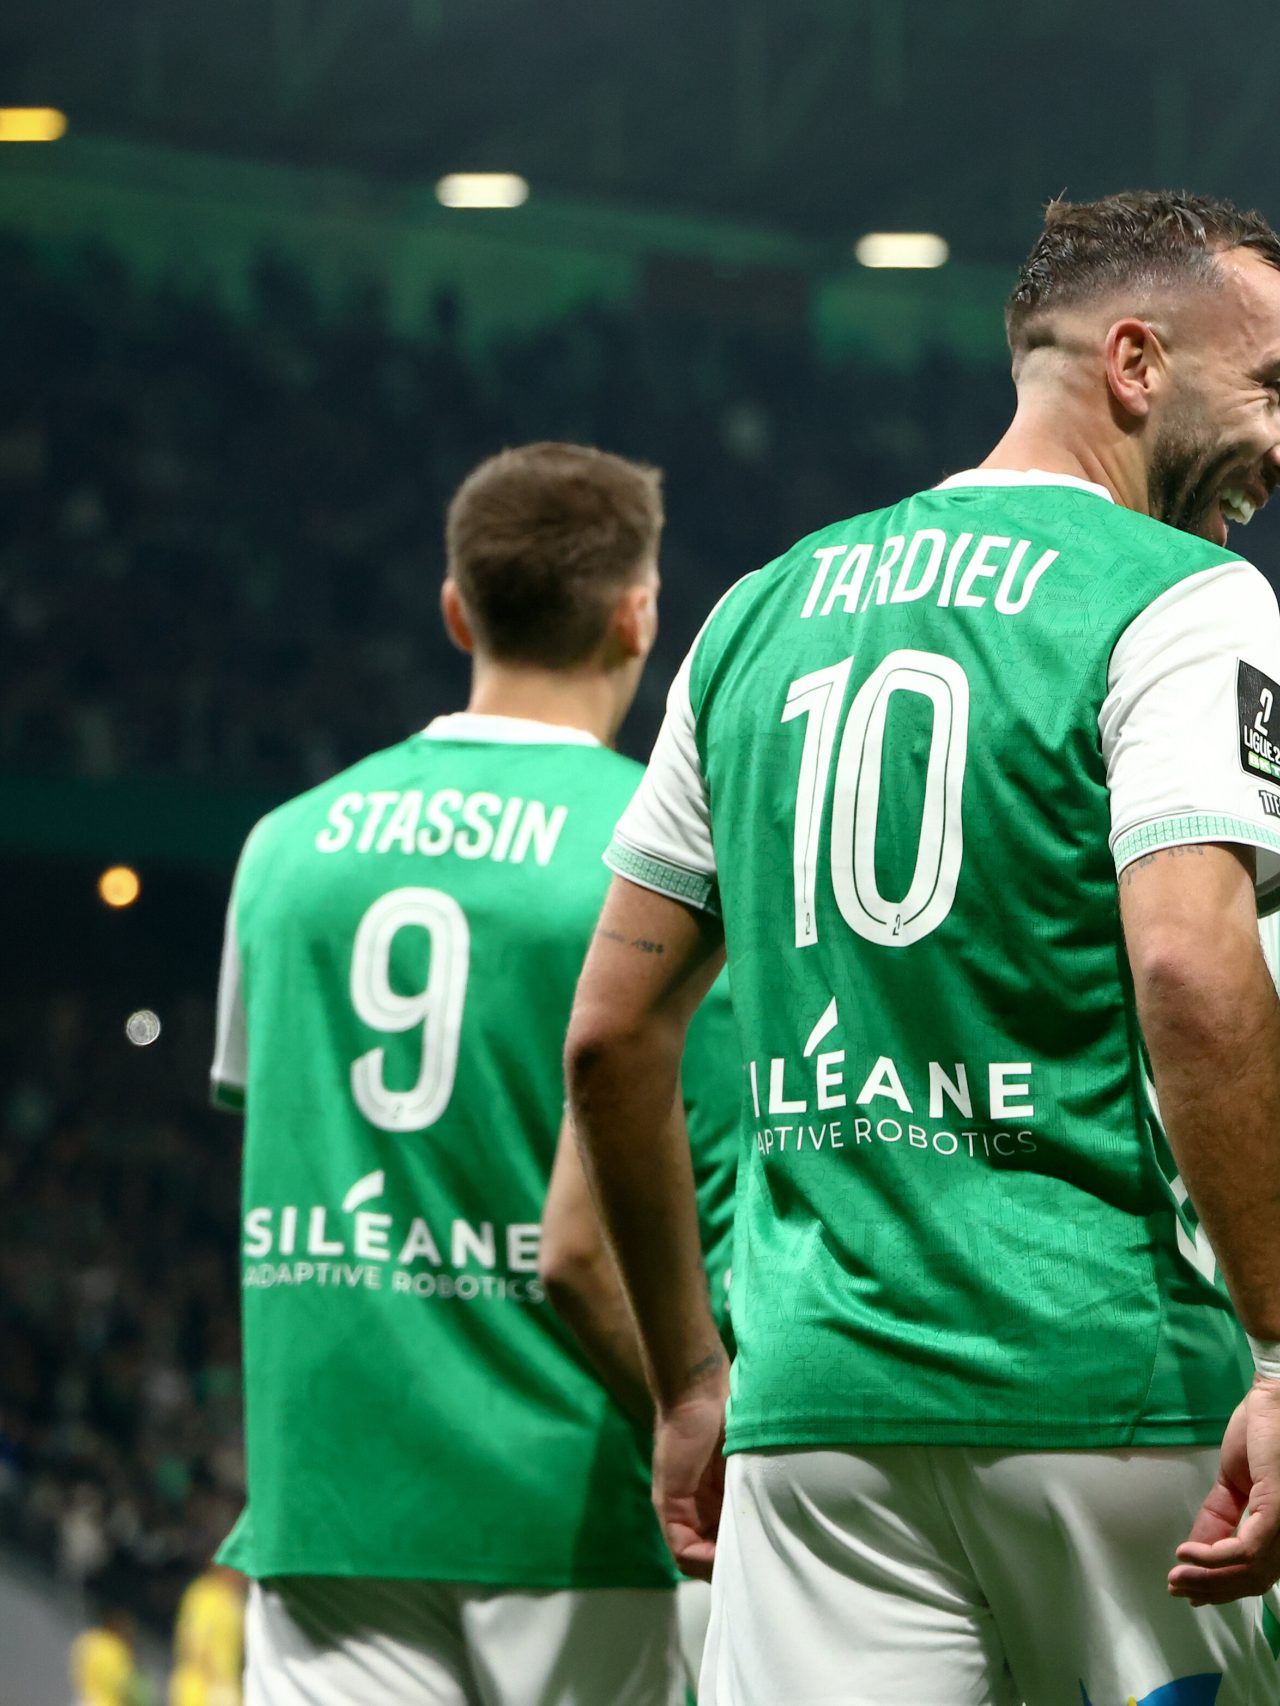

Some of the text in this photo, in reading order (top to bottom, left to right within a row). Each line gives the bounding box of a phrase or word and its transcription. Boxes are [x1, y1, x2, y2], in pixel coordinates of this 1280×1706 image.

[801, 528, 1060, 619] TARDIEU
[1254, 687, 1273, 737] 2
[315, 789, 569, 867] STASSIN
[780, 649, 970, 948] 10
[350, 886, 471, 1132] 9
[749, 996, 1034, 1119] ILÉANE
[757, 1118, 1037, 1157] APTIVE ROBOTICS
[242, 1262, 545, 1303] ADAPTIVE ROBOTICS
